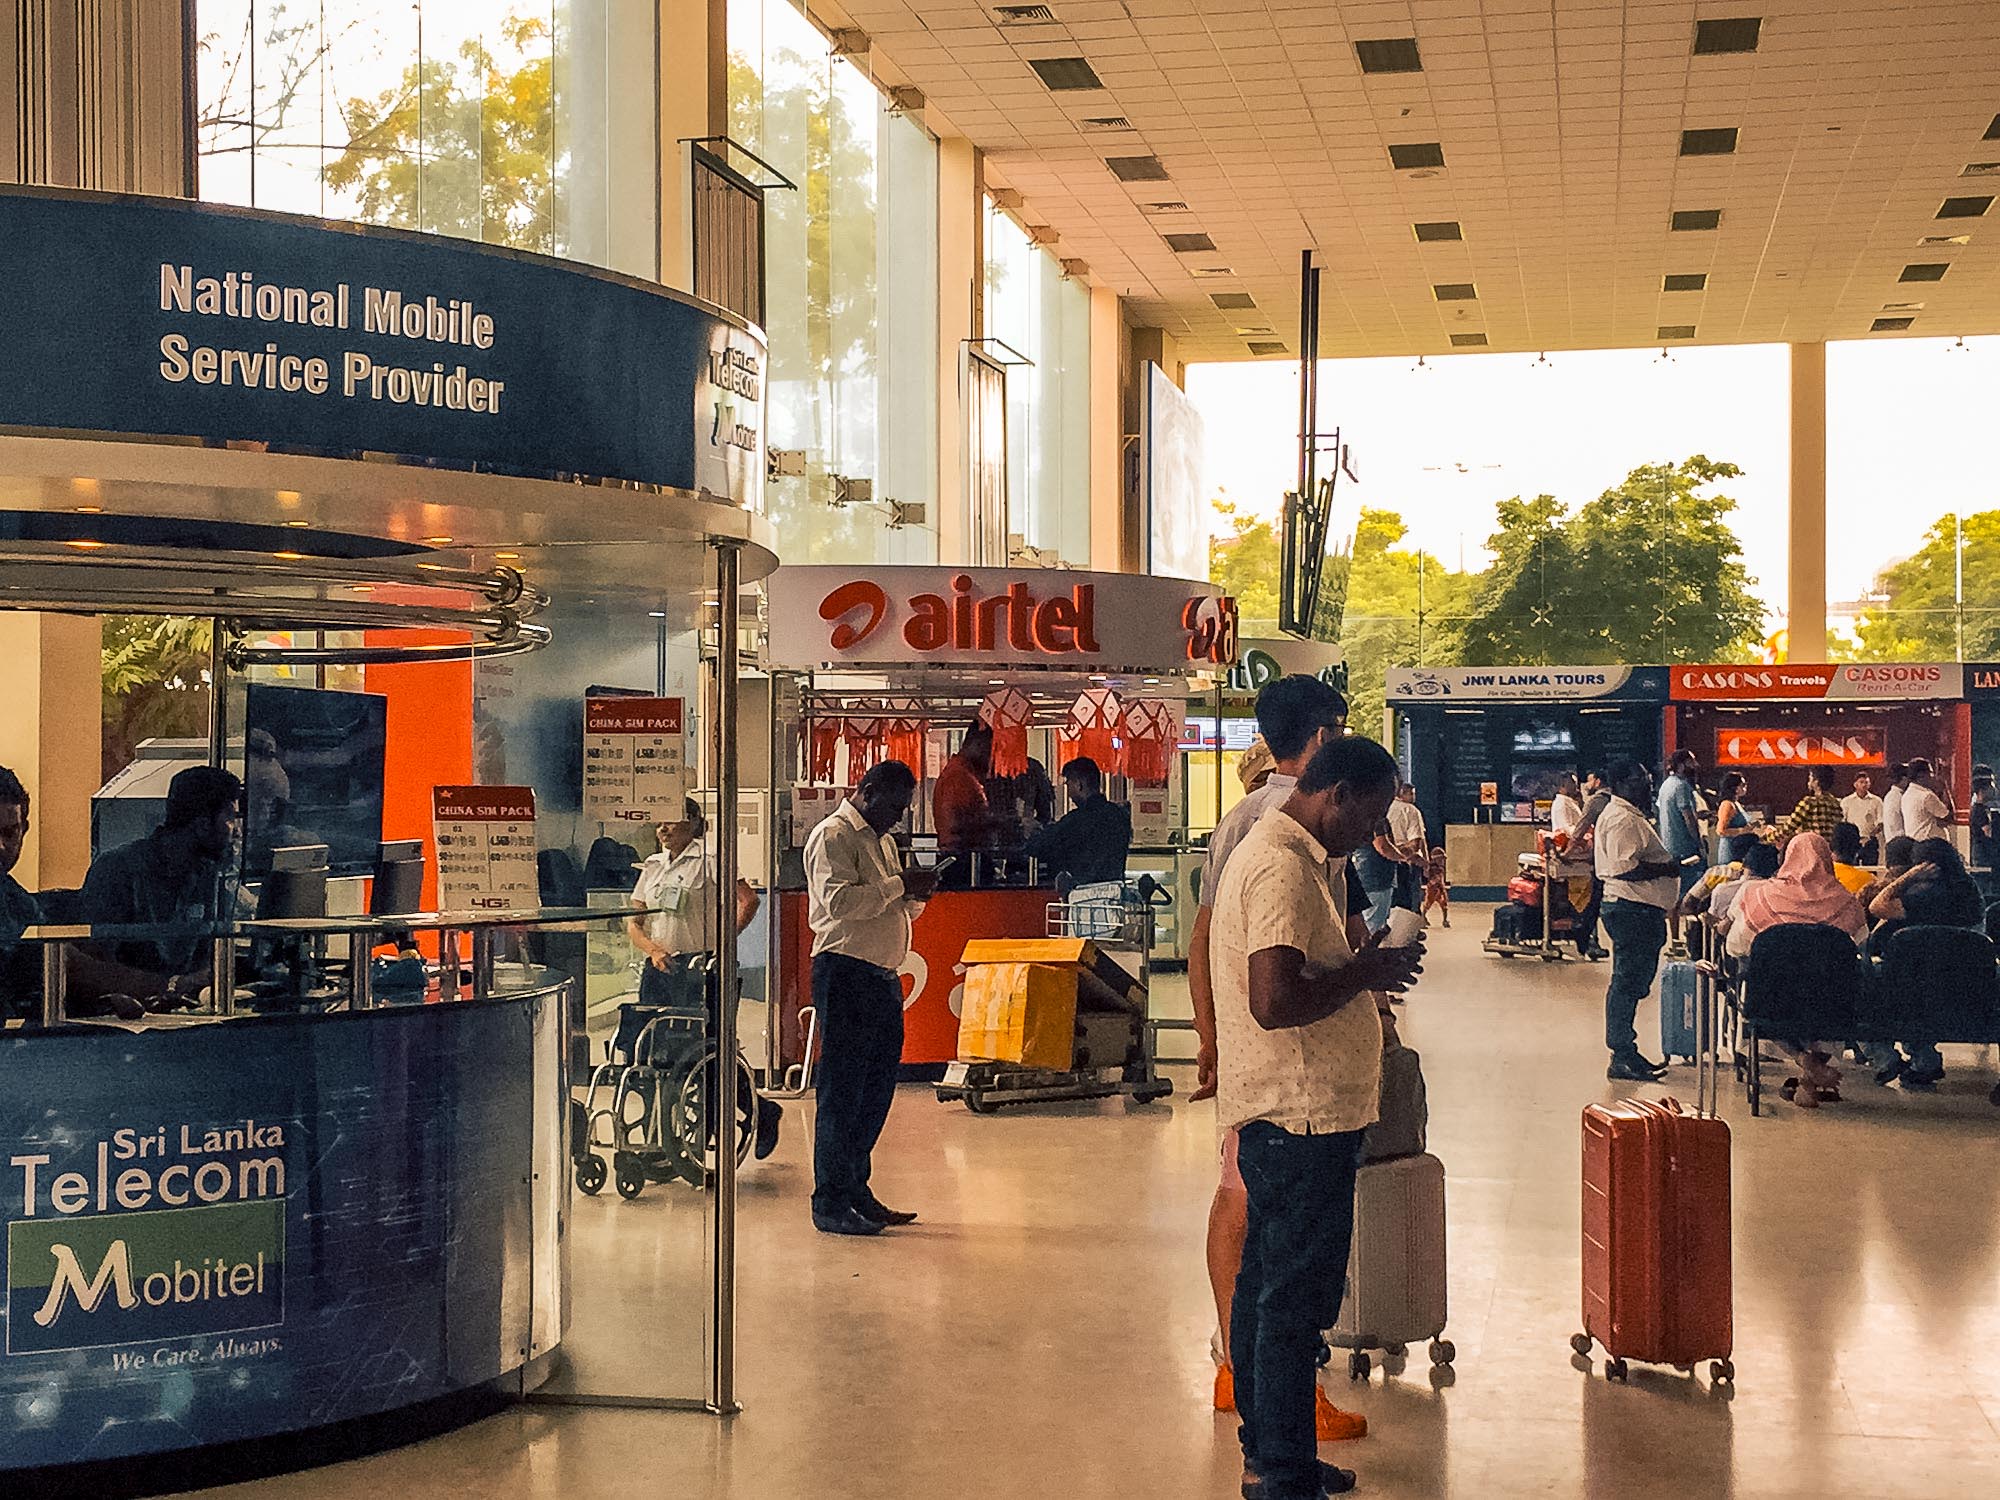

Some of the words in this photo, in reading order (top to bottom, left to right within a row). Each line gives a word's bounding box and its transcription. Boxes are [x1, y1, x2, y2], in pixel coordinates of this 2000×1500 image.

[160, 264, 350, 329] National
[364, 287, 495, 350] Mobile
[160, 333, 329, 395] Service
[344, 352, 504, 414] Provider
[903, 574, 1101, 654] airtel
[1462, 675, 1495, 686] JNW
[1498, 674, 1551, 686] LANKA
[1554, 674, 1606, 685] TOURS
[1682, 671, 1774, 689] CASONS
[1779, 674, 1827, 686] Travels
[1845, 666, 1941, 682] CASONS
[1855, 682, 1933, 693] Rent-A-Car
[589, 718, 623, 729] CHINA
[625, 718, 645, 729] SIM
[647, 718, 678, 729] PACK
[1727, 736, 1866, 760] CASONS
[438, 805, 474, 816] CHINA
[476, 805, 497, 816] SIM
[500, 805, 533, 816] PACK
[114, 1126, 166, 1160] Sri
[181, 1119, 285, 1155] Lanka
[11, 1141, 285, 1216] Telecom
[34, 1239, 265, 1328] Mobitel
[112, 1351, 145, 1372] We
